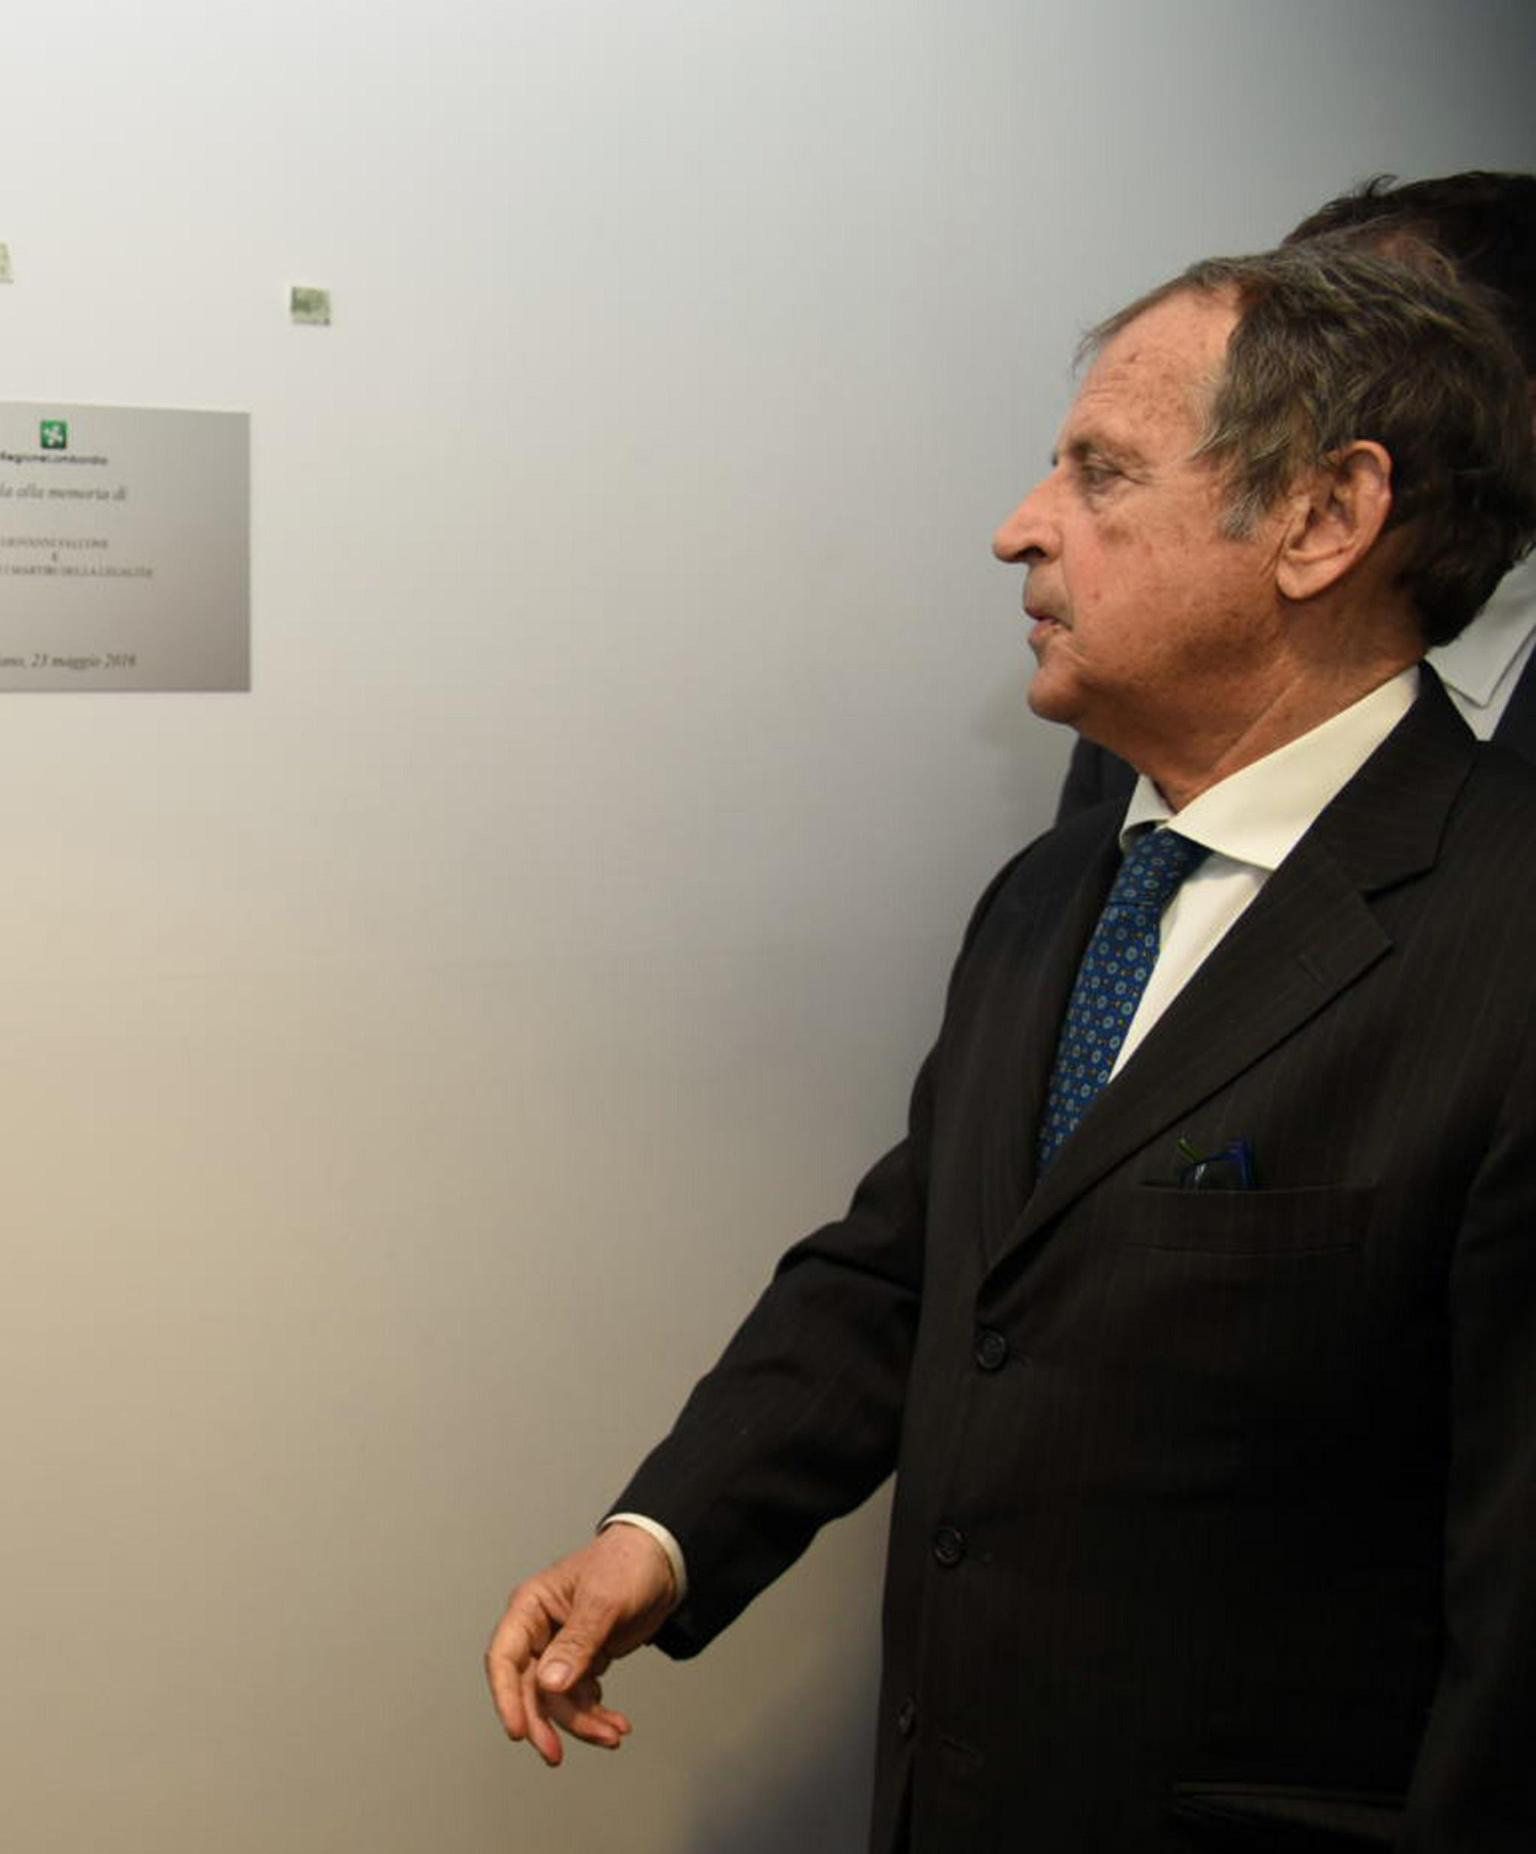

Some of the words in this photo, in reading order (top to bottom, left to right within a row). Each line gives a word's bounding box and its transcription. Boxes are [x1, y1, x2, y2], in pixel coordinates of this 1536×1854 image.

[15, 481, 44, 499] alla
[48, 485, 110, 500] memoria
[112, 484, 127, 501] di
[30, 653, 49, 669] 23
[51, 653, 101, 671] maggio
